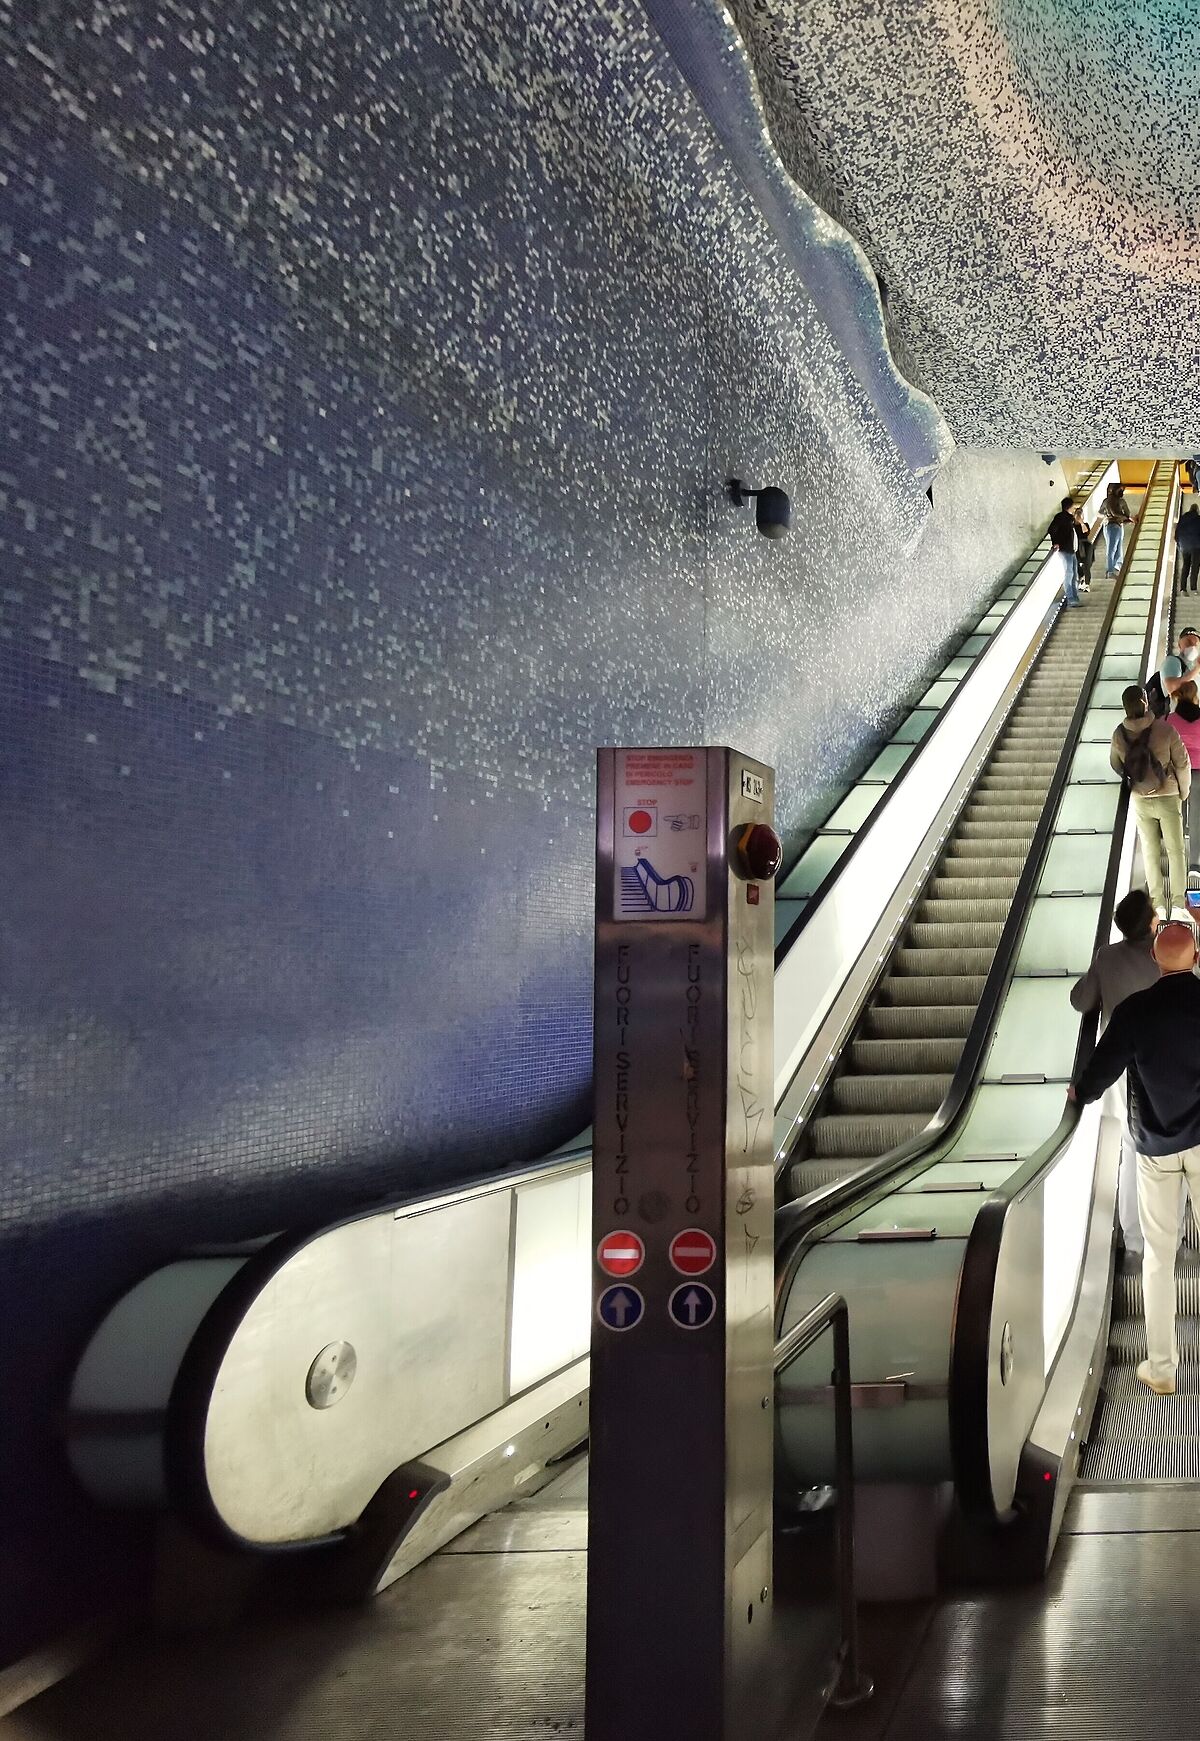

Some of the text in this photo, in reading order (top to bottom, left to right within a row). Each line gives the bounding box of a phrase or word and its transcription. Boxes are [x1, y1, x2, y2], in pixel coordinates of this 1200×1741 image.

[613, 944, 632, 1216] FUORI SERVIZIO
[685, 943, 702, 1046] FUORI
